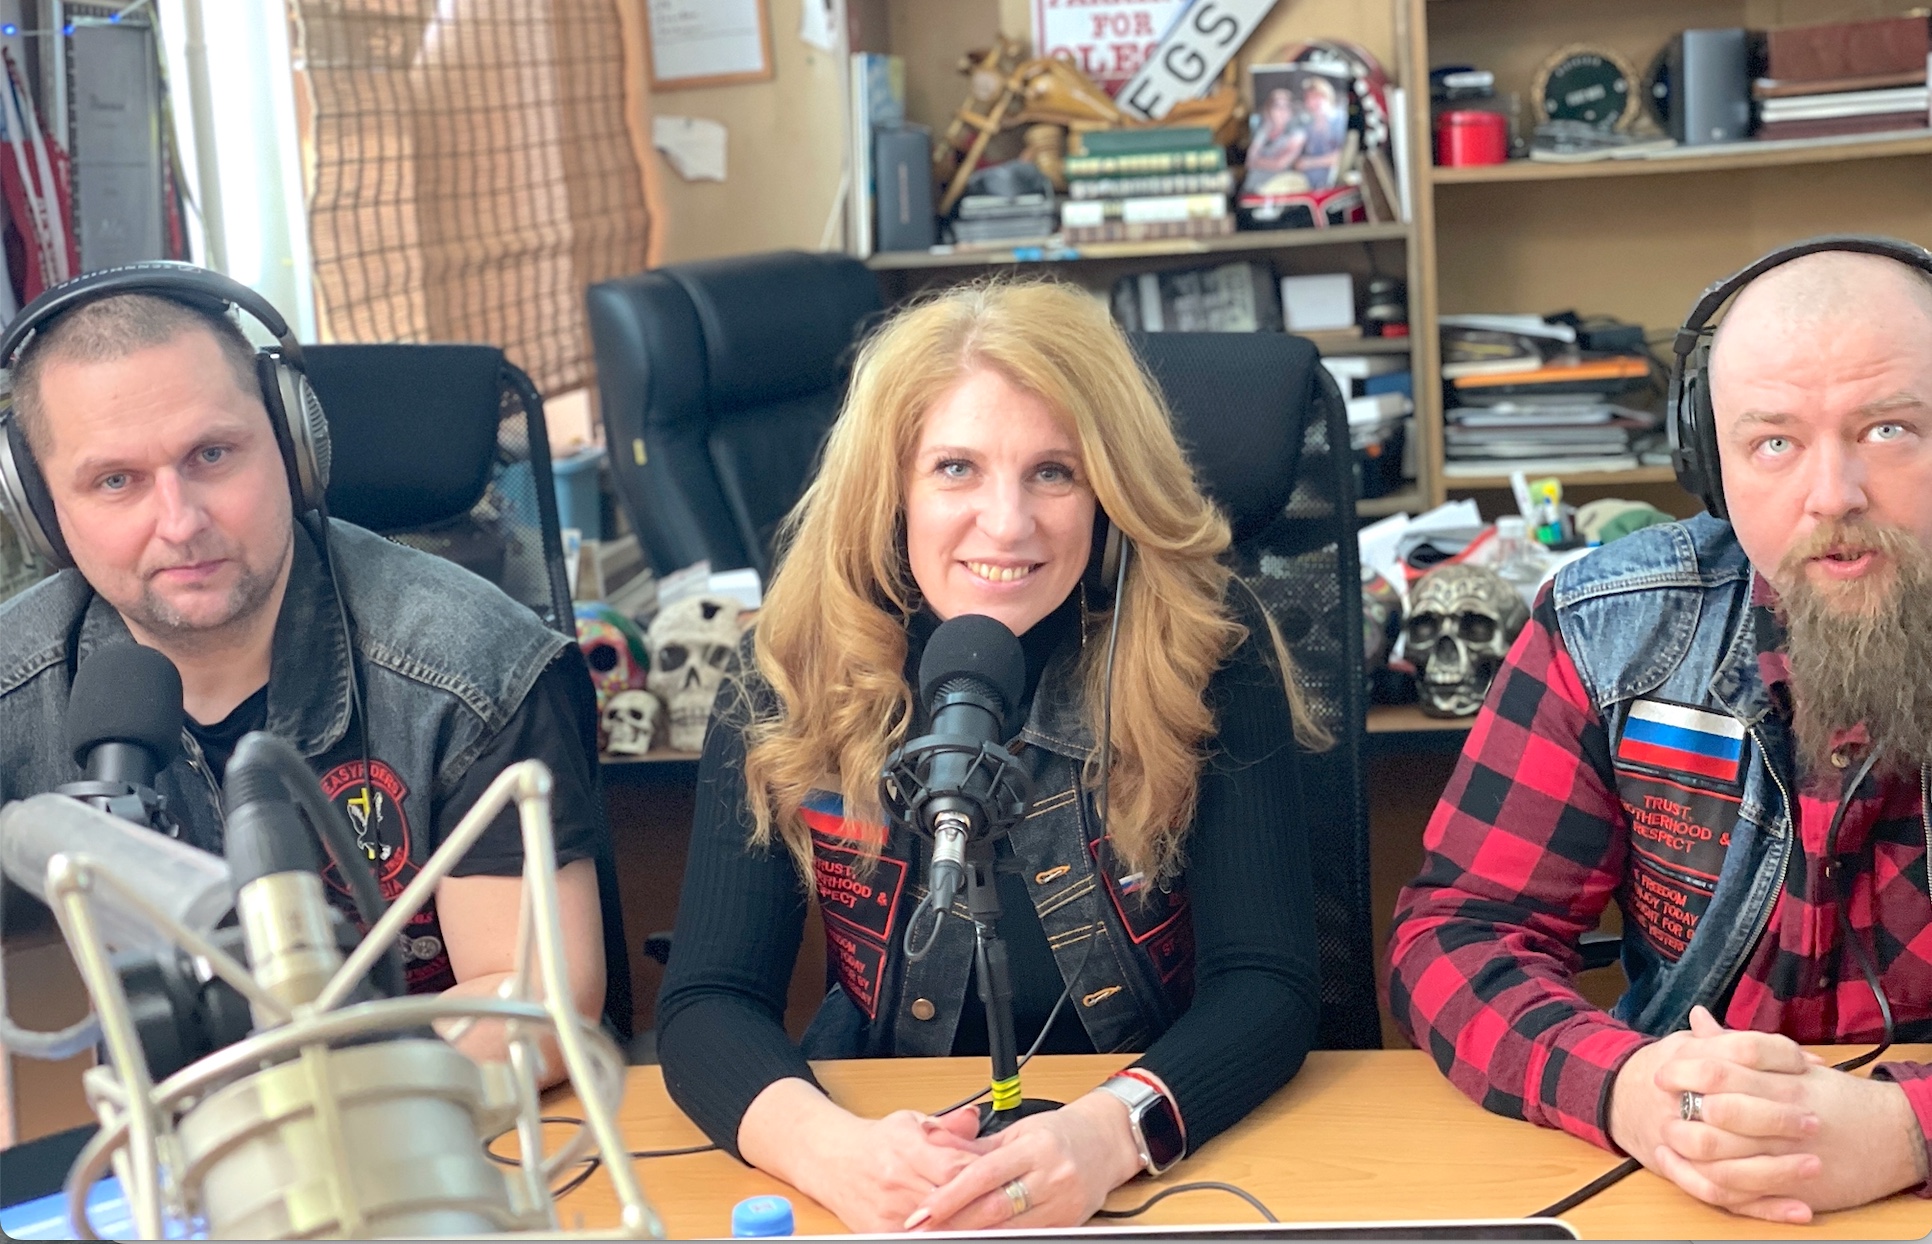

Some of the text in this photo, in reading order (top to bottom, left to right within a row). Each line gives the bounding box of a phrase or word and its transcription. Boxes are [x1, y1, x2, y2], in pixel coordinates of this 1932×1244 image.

[1090, 12, 1154, 38] FOR
[1633, 820, 1696, 853] RESPECT
[876, 891, 887, 907] &
[1641, 873, 1688, 907] FREEDOM
[1662, 900, 1699, 927] TODAY
[1661, 916, 1684, 938] FOR
